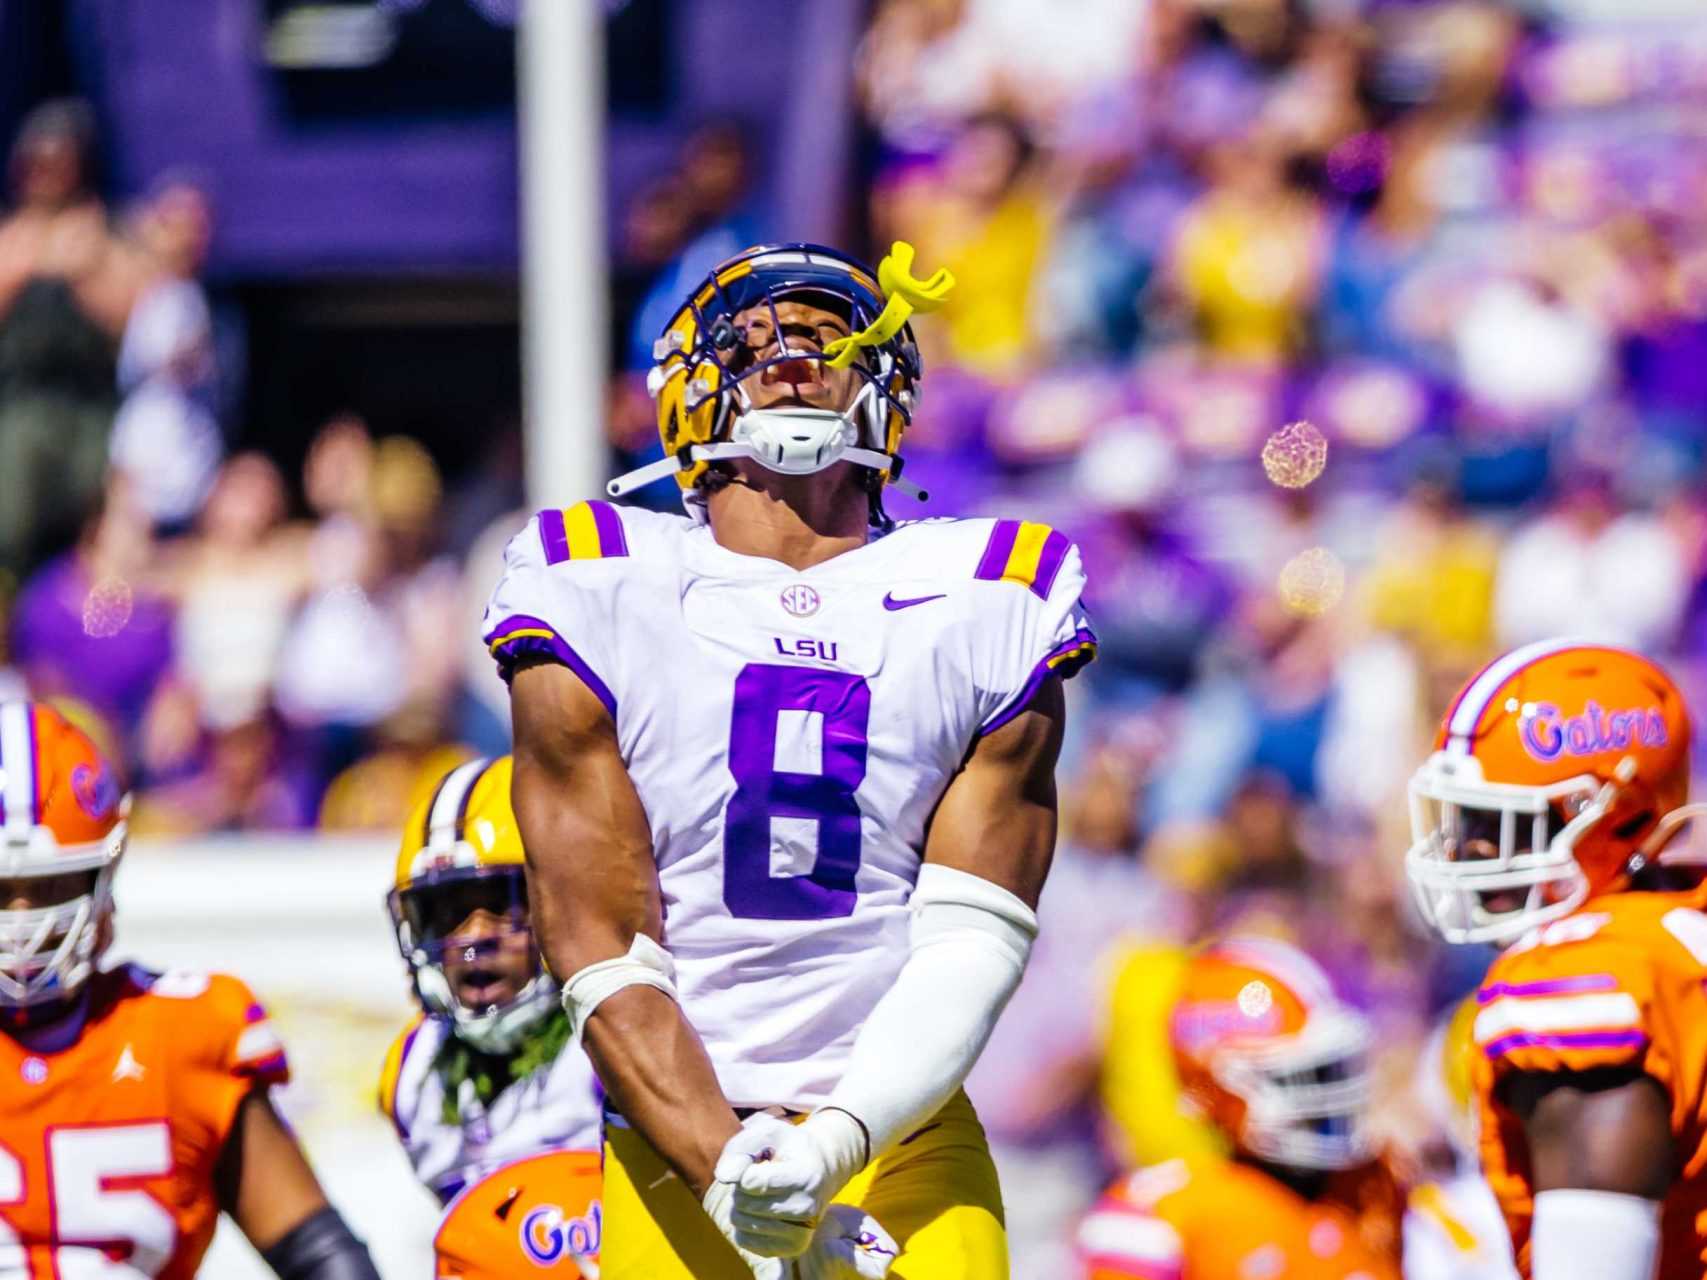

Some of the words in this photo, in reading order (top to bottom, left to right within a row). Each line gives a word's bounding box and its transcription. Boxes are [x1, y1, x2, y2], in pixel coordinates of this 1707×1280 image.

[781, 586, 820, 615] SEC
[774, 637, 837, 661] LSU
[1518, 700, 1667, 763] Gators
[722, 662, 872, 921] 8
[519, 1200, 602, 1268] Gat
